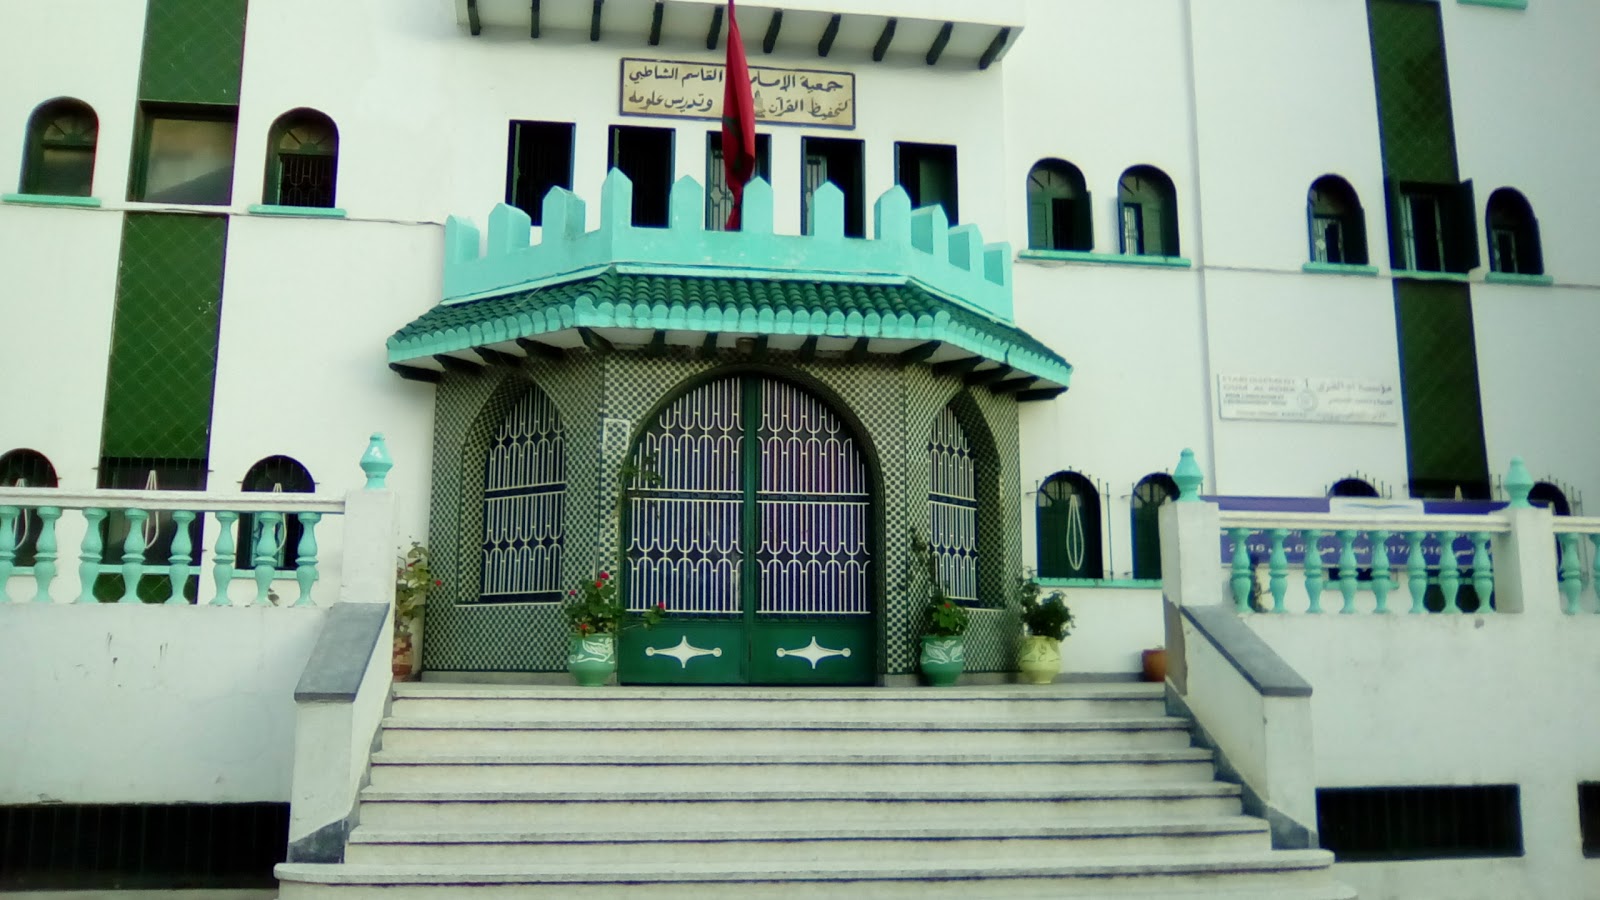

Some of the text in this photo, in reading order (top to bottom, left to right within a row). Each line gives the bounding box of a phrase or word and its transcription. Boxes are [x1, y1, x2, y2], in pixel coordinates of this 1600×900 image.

[629, 65, 679, 84] الشاطبي
[682, 67, 723, 88] القاسم
[800, 75, 843, 93] جمعية
[628, 90, 664, 110] علومه
[664, 93, 713, 113] وتدريس
[769, 97, 804, 117] القرآن
